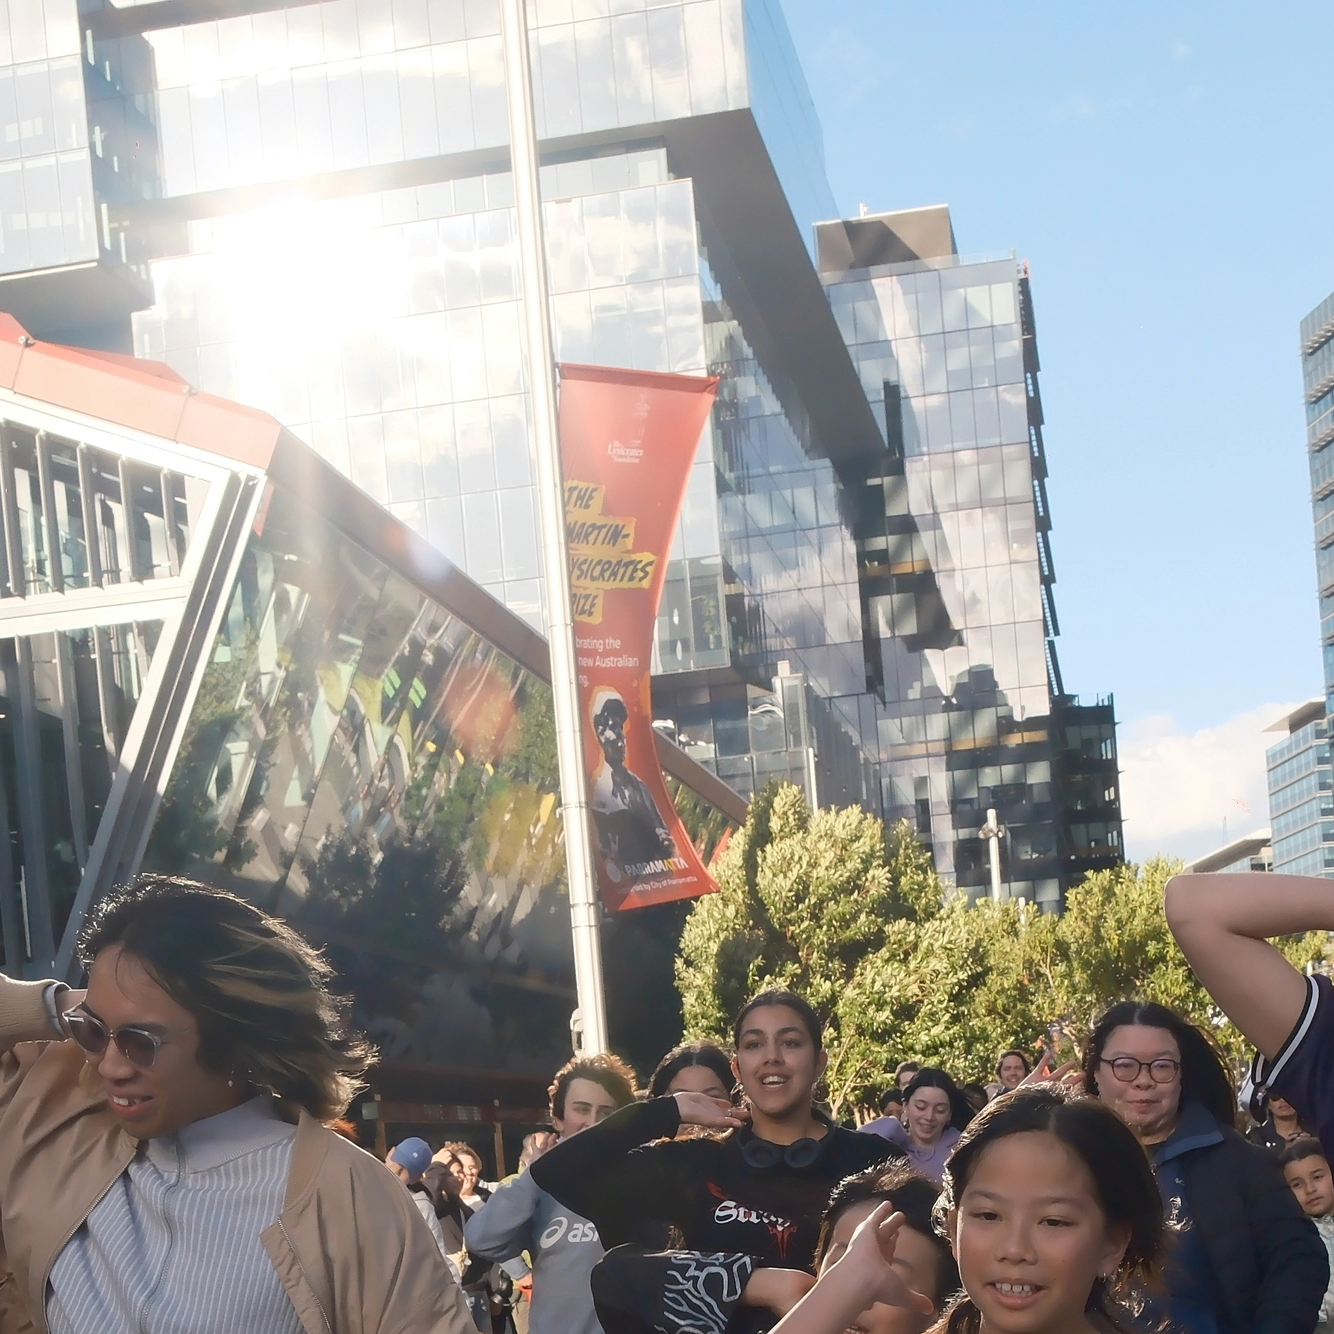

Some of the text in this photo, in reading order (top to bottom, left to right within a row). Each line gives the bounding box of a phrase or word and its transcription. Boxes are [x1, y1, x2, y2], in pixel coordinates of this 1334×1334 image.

[567, 486, 599, 509] THE
[605, 636, 622, 649] the
[594, 655, 640, 668] Australian
[624, 857, 689, 877] PARRAMATTA
